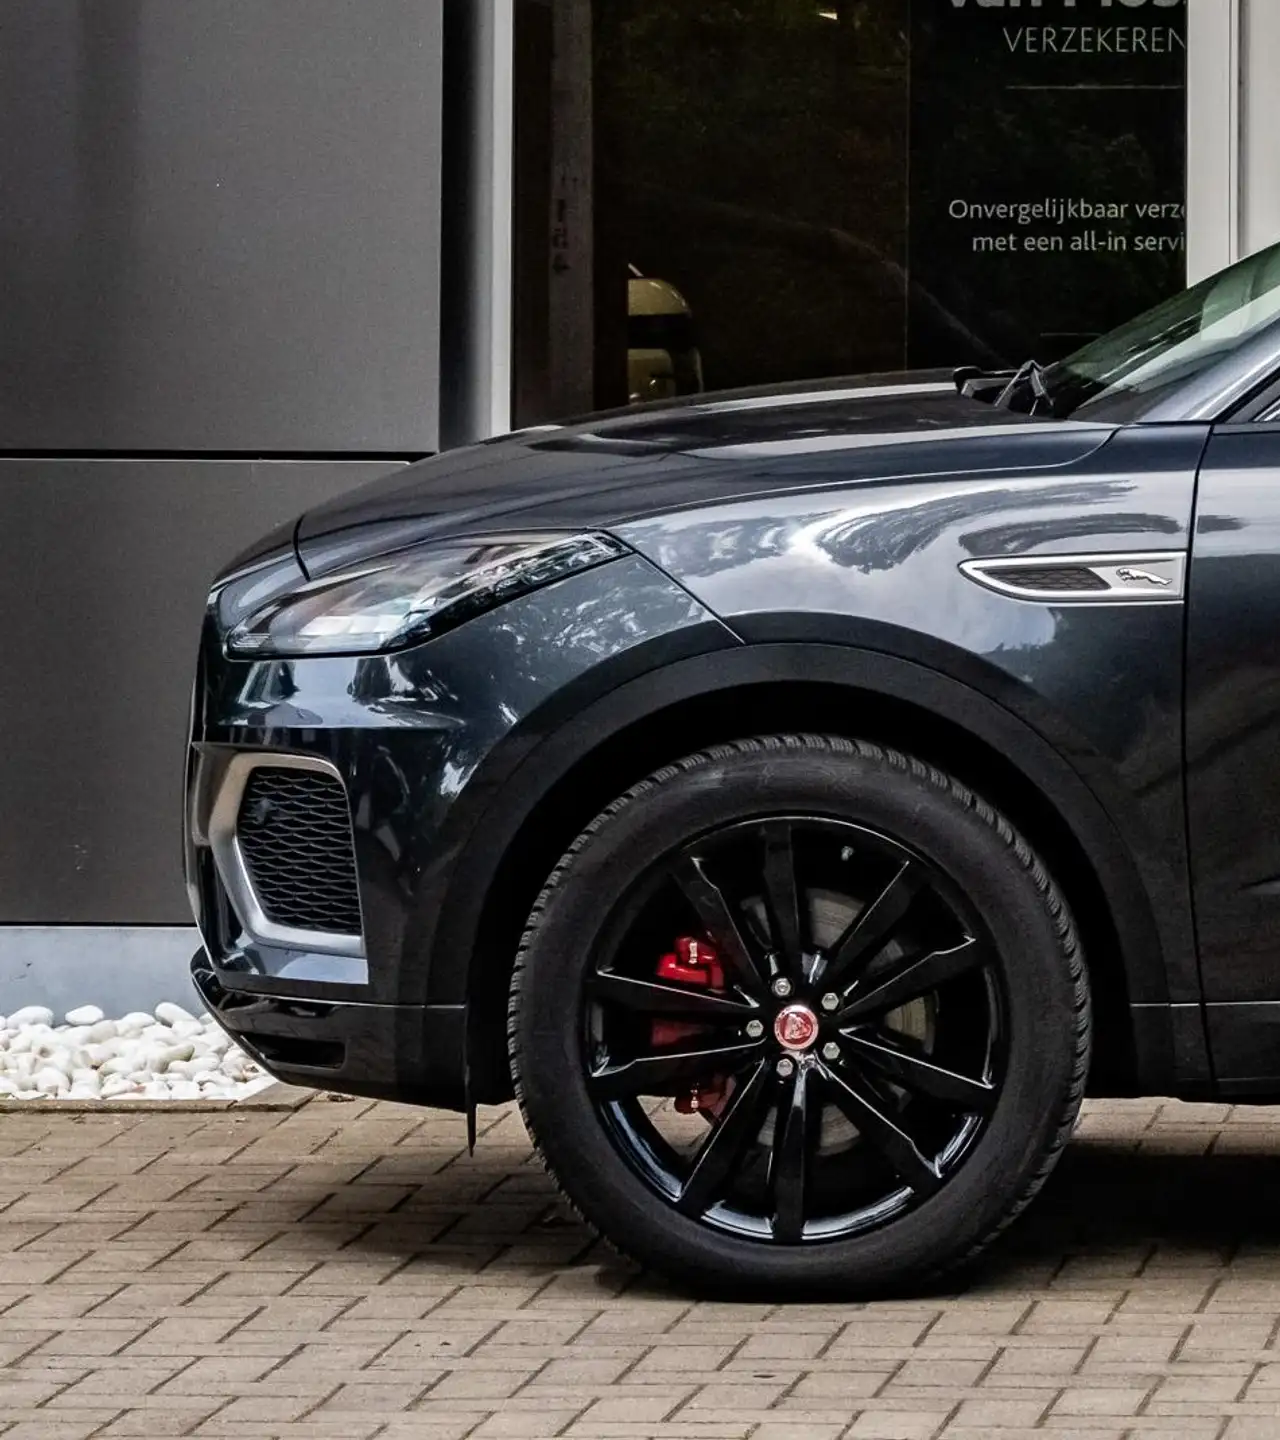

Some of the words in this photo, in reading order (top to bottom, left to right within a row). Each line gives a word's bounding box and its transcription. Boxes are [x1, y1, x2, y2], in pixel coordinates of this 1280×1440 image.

[948, 198, 1127, 225] Onvergelijkbaar
[1135, 203, 1185, 218] verz
[972, 234, 1017, 251] met
[1023, 237, 1063, 251] een
[1070, 231, 1126, 251] all-in
